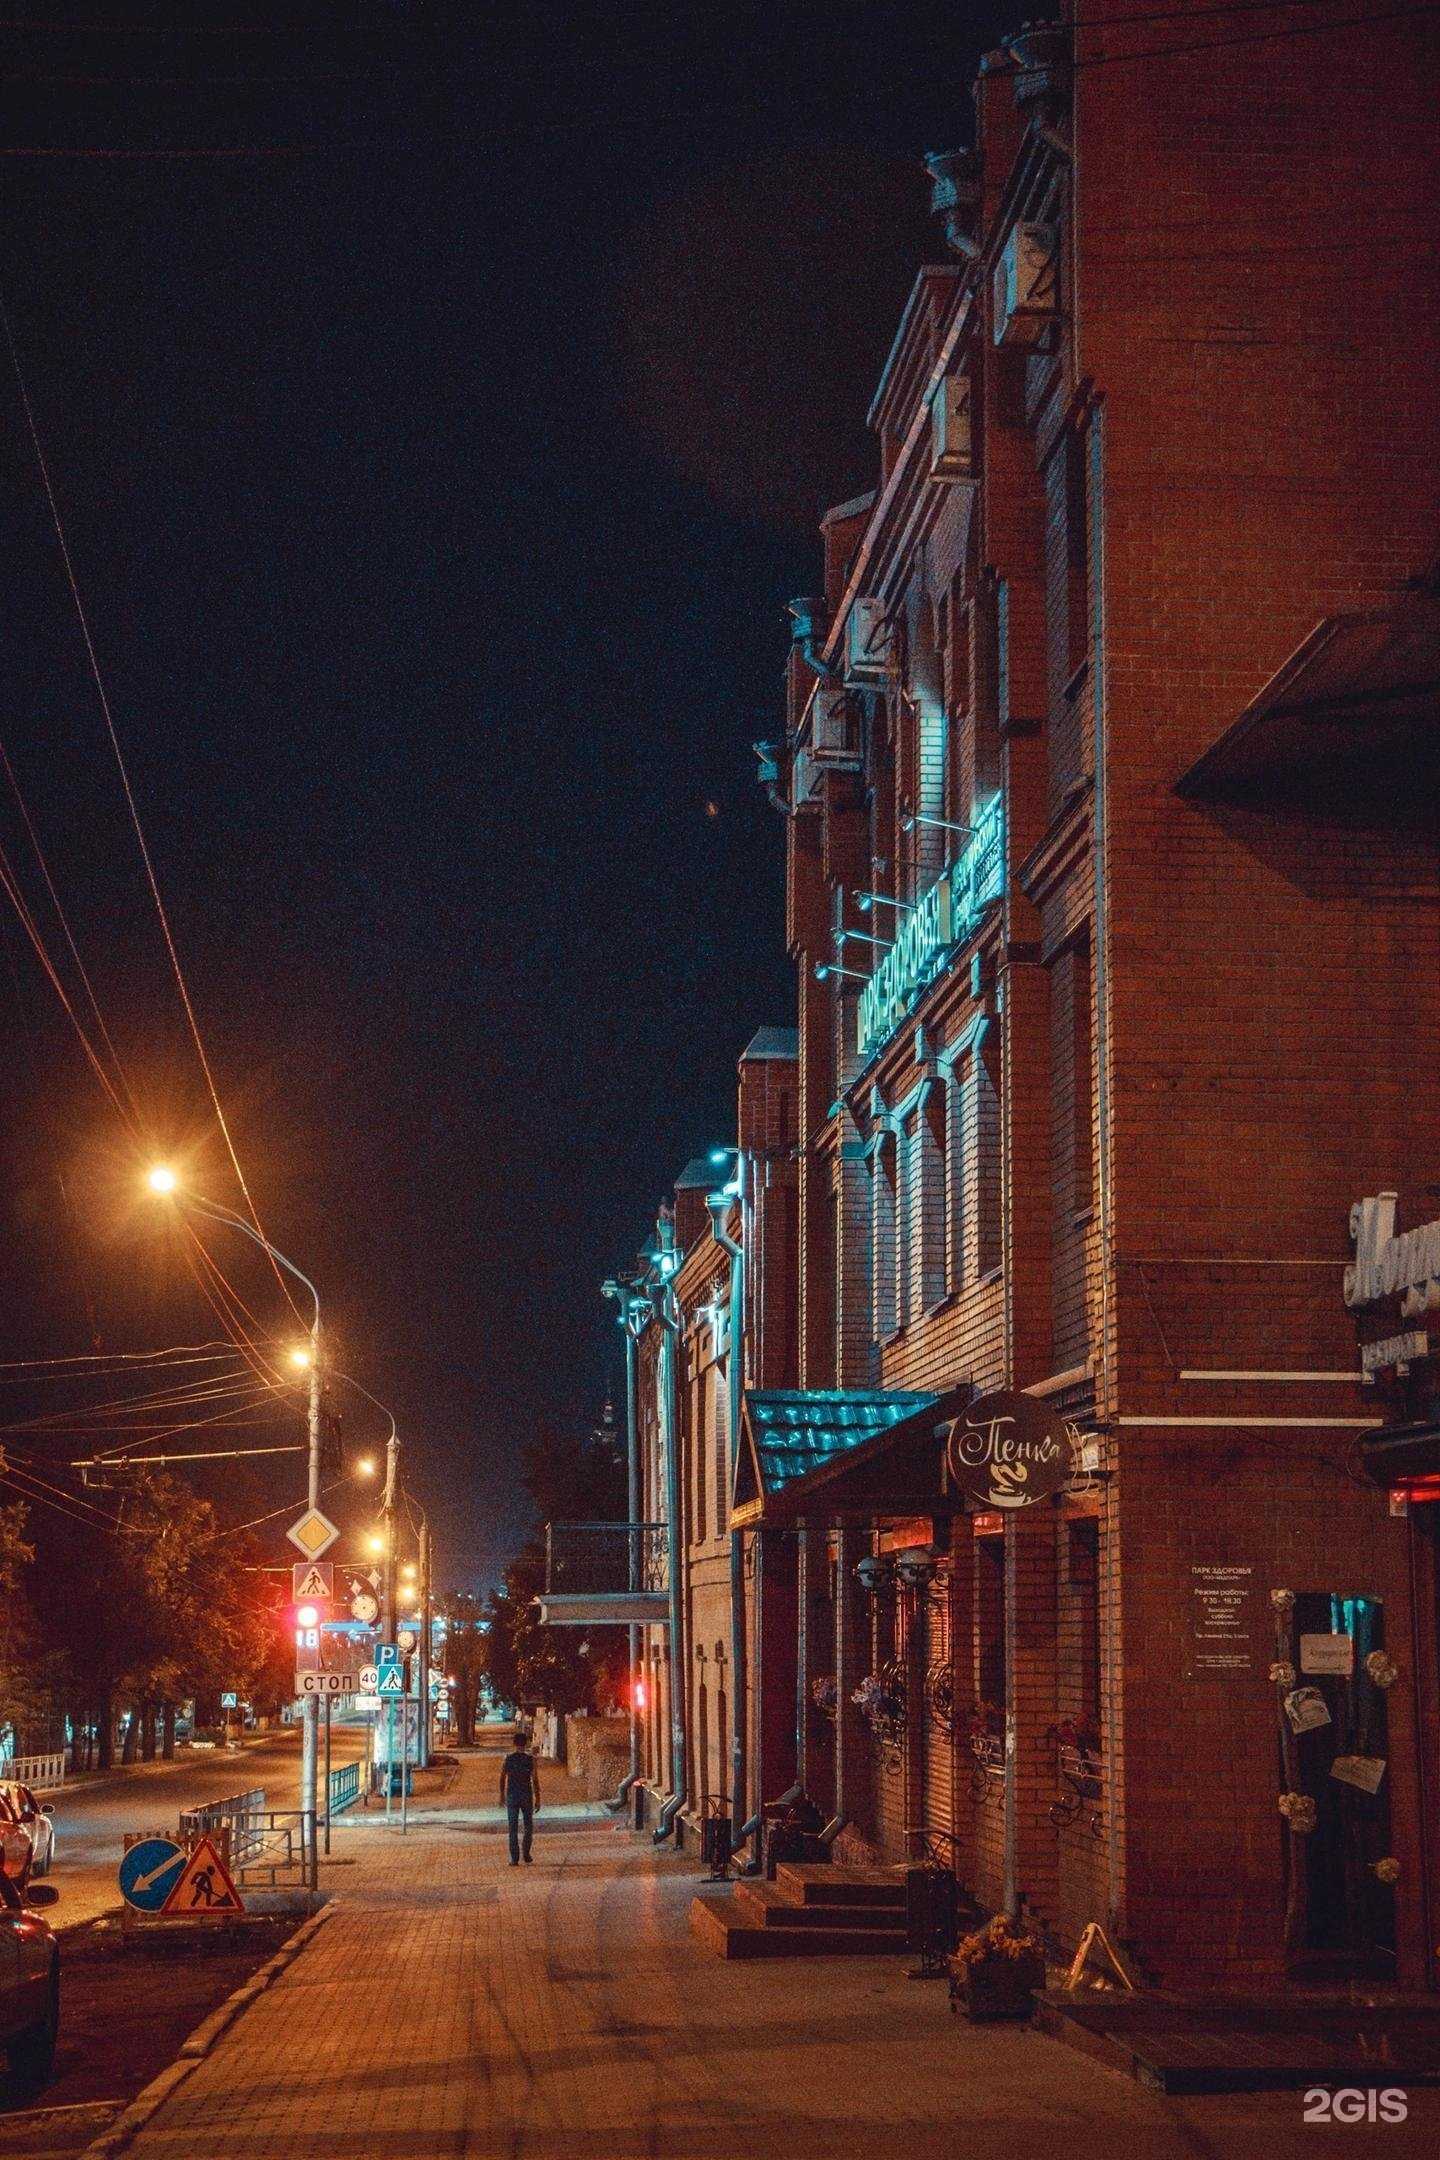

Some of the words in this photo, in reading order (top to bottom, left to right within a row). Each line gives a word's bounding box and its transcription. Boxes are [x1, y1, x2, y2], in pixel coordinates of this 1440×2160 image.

[959, 1416, 1060, 1466] Пенка
[1191, 1567, 1211, 1575] ПАРК
[1211, 1567, 1252, 1575] ЗДОРОВЬЯ
[1194, 1588, 1219, 1596] Режим
[303, 1675, 353, 1691] СТОП
[361, 1673, 378, 1684] 40
